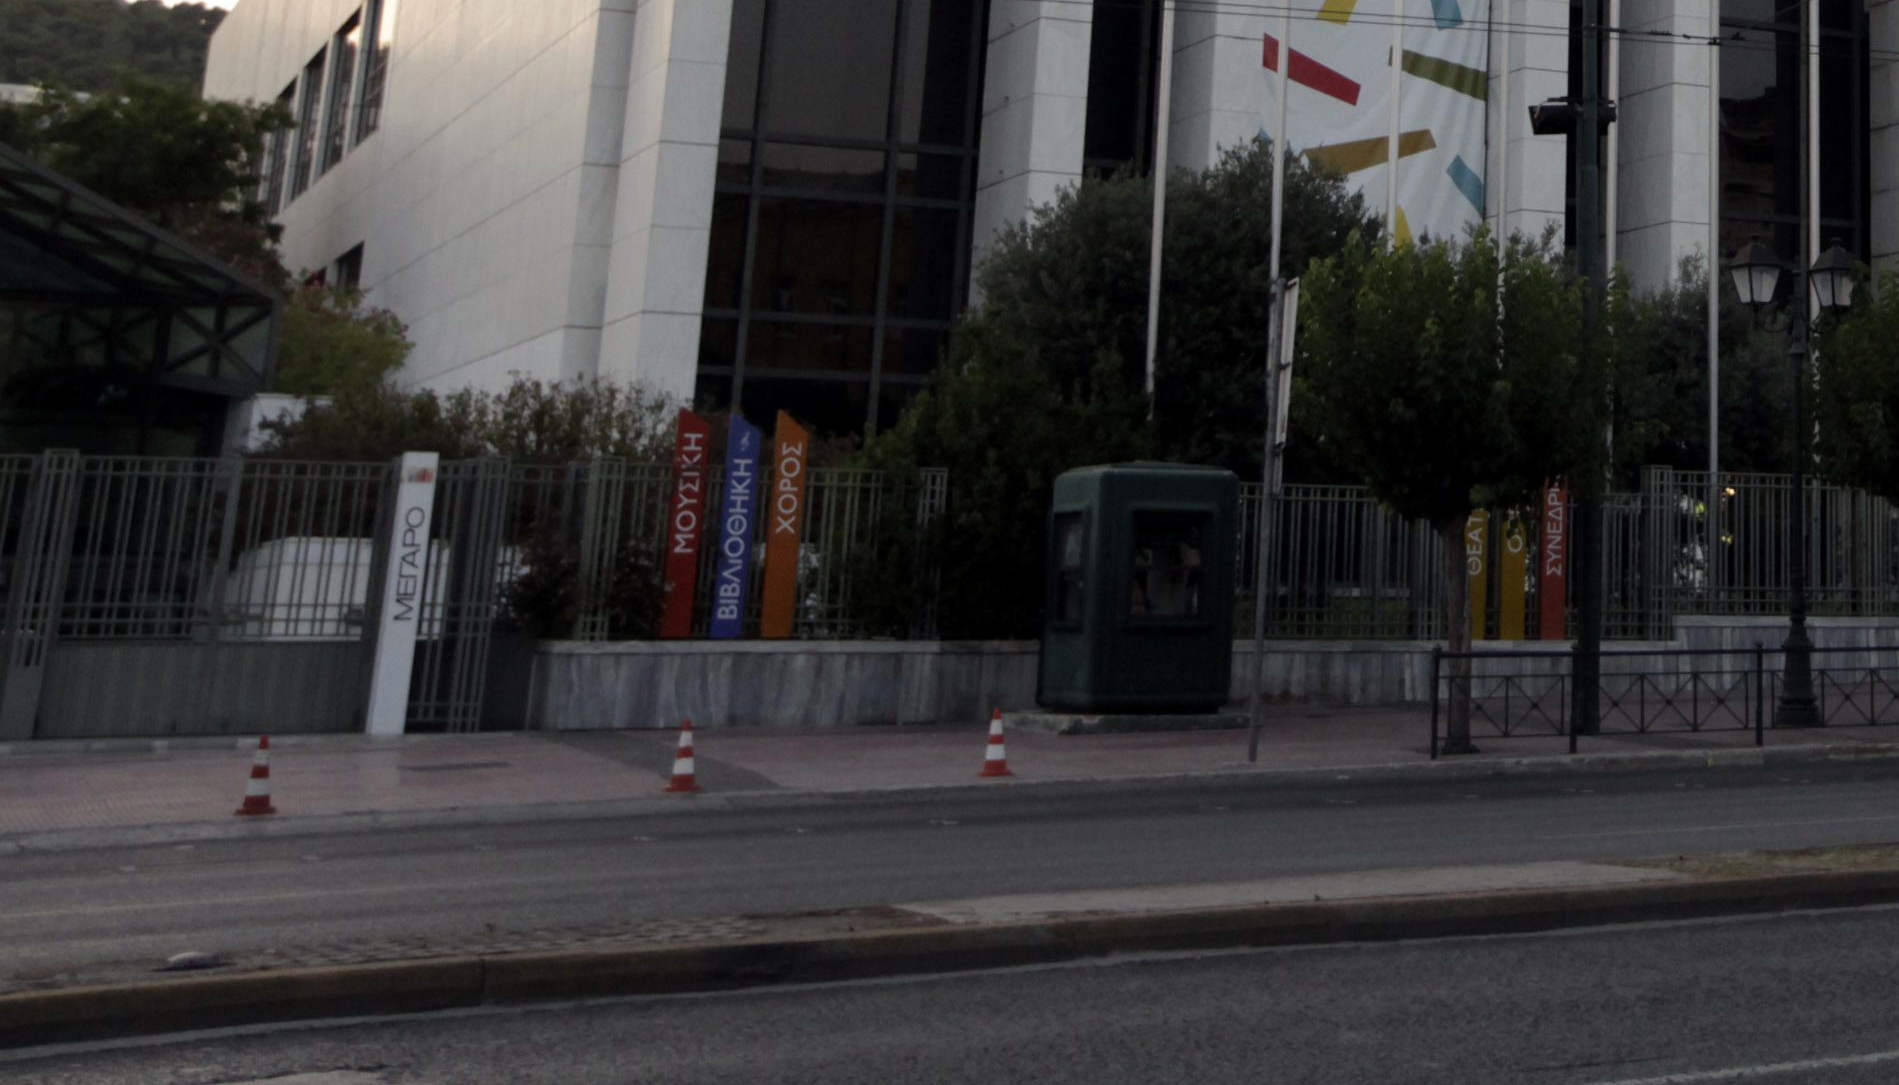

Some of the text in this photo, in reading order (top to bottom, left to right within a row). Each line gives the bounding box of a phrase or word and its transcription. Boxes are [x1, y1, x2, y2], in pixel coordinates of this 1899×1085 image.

[673, 433, 704, 554] ΜΟΥΣΙΚΗ
[717, 458, 753, 620] ΒΙΒΛΙΟΘΗΚΗ
[776, 442, 802, 534] ΧΟΡΟΣ
[1467, 514, 1484, 576] ΘΕΑΤ
[394, 506, 425, 620] ΜΕΓΑΡΟ
